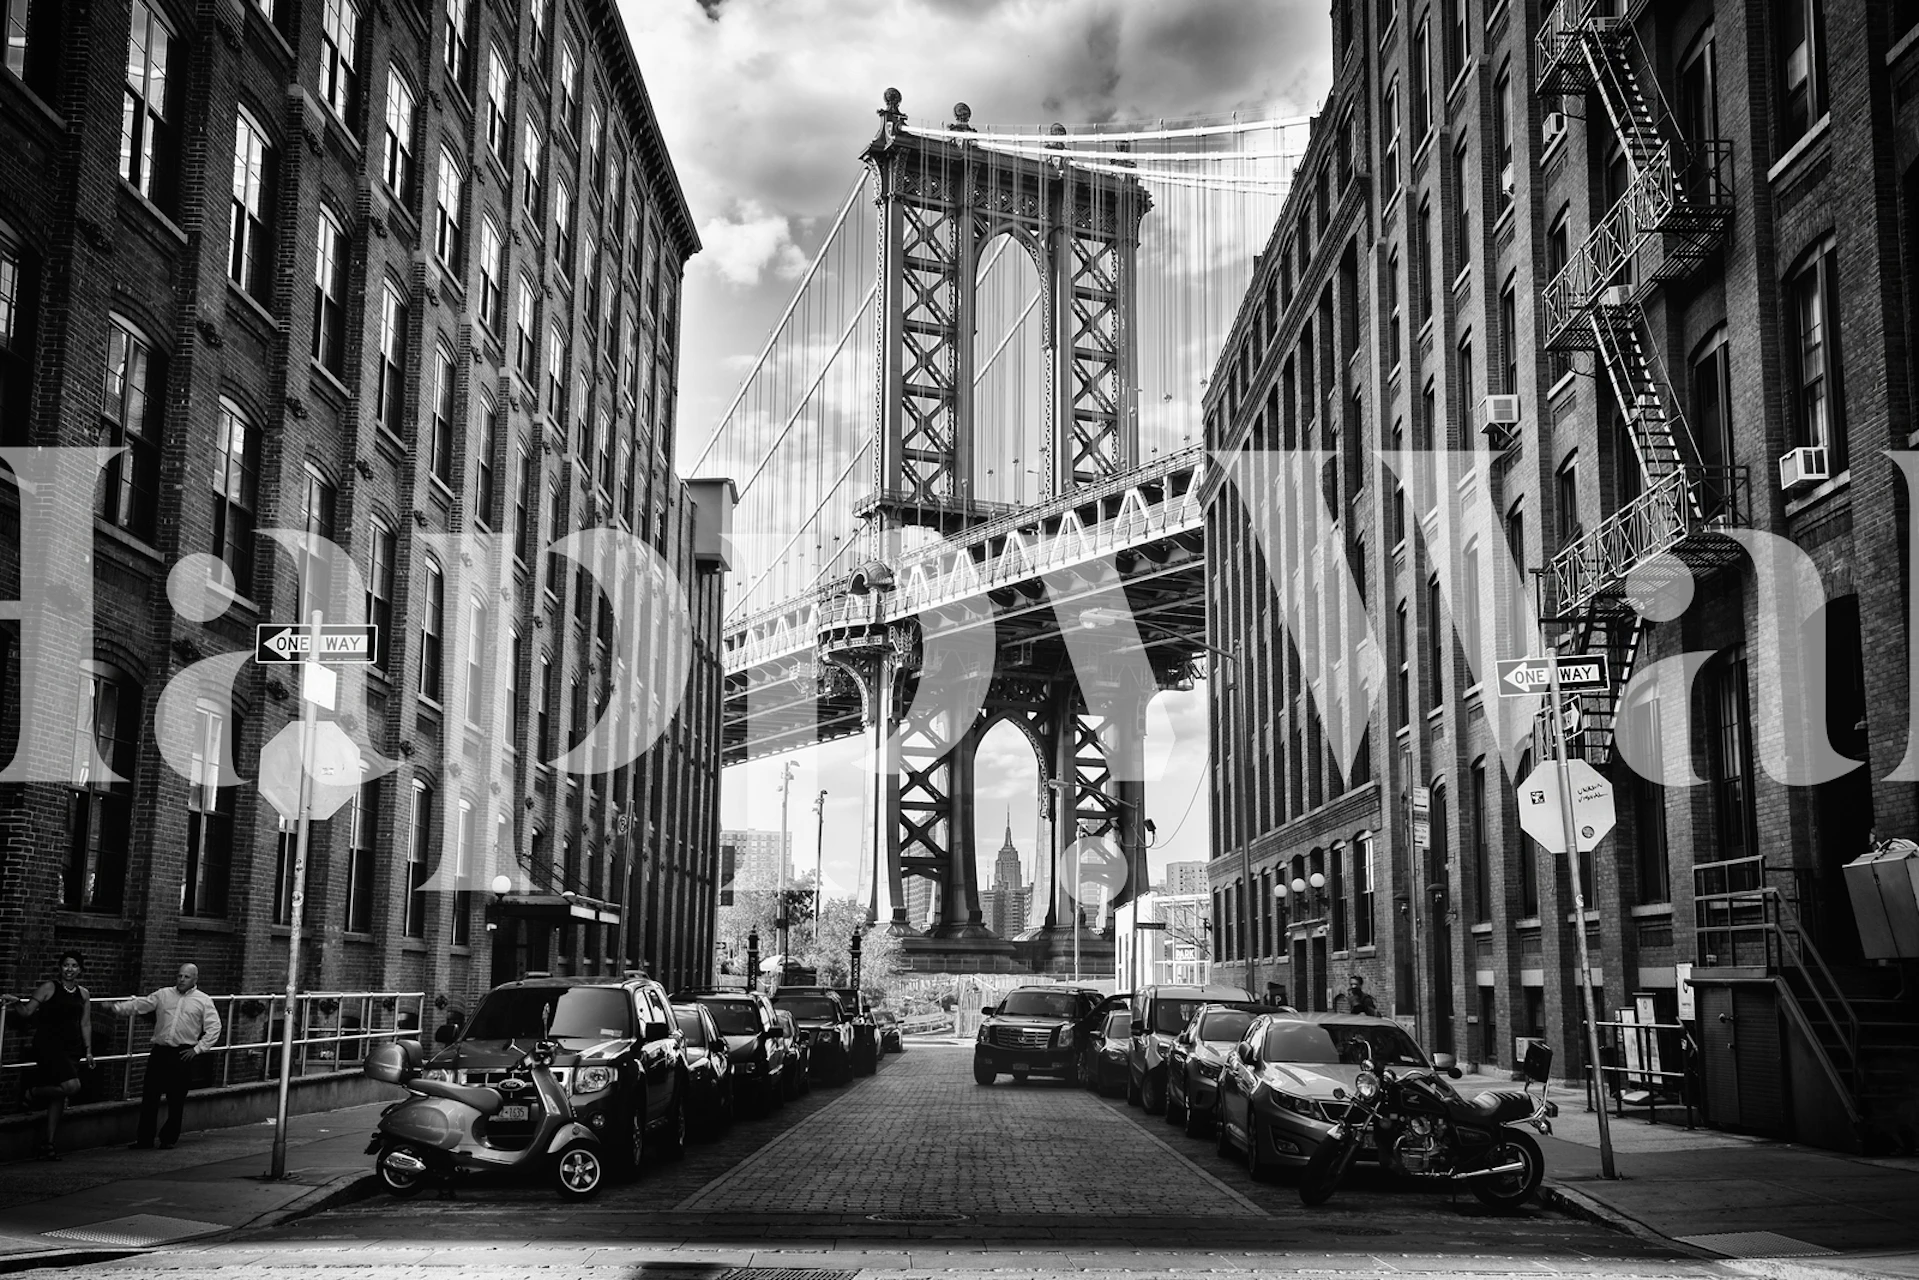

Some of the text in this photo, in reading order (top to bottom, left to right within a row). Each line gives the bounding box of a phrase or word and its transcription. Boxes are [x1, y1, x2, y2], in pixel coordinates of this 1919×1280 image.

[276, 636, 361, 651] ONE WAY
[1514, 666, 1592, 684] ONE WAY
[1175, 949, 1195, 959] PARK
